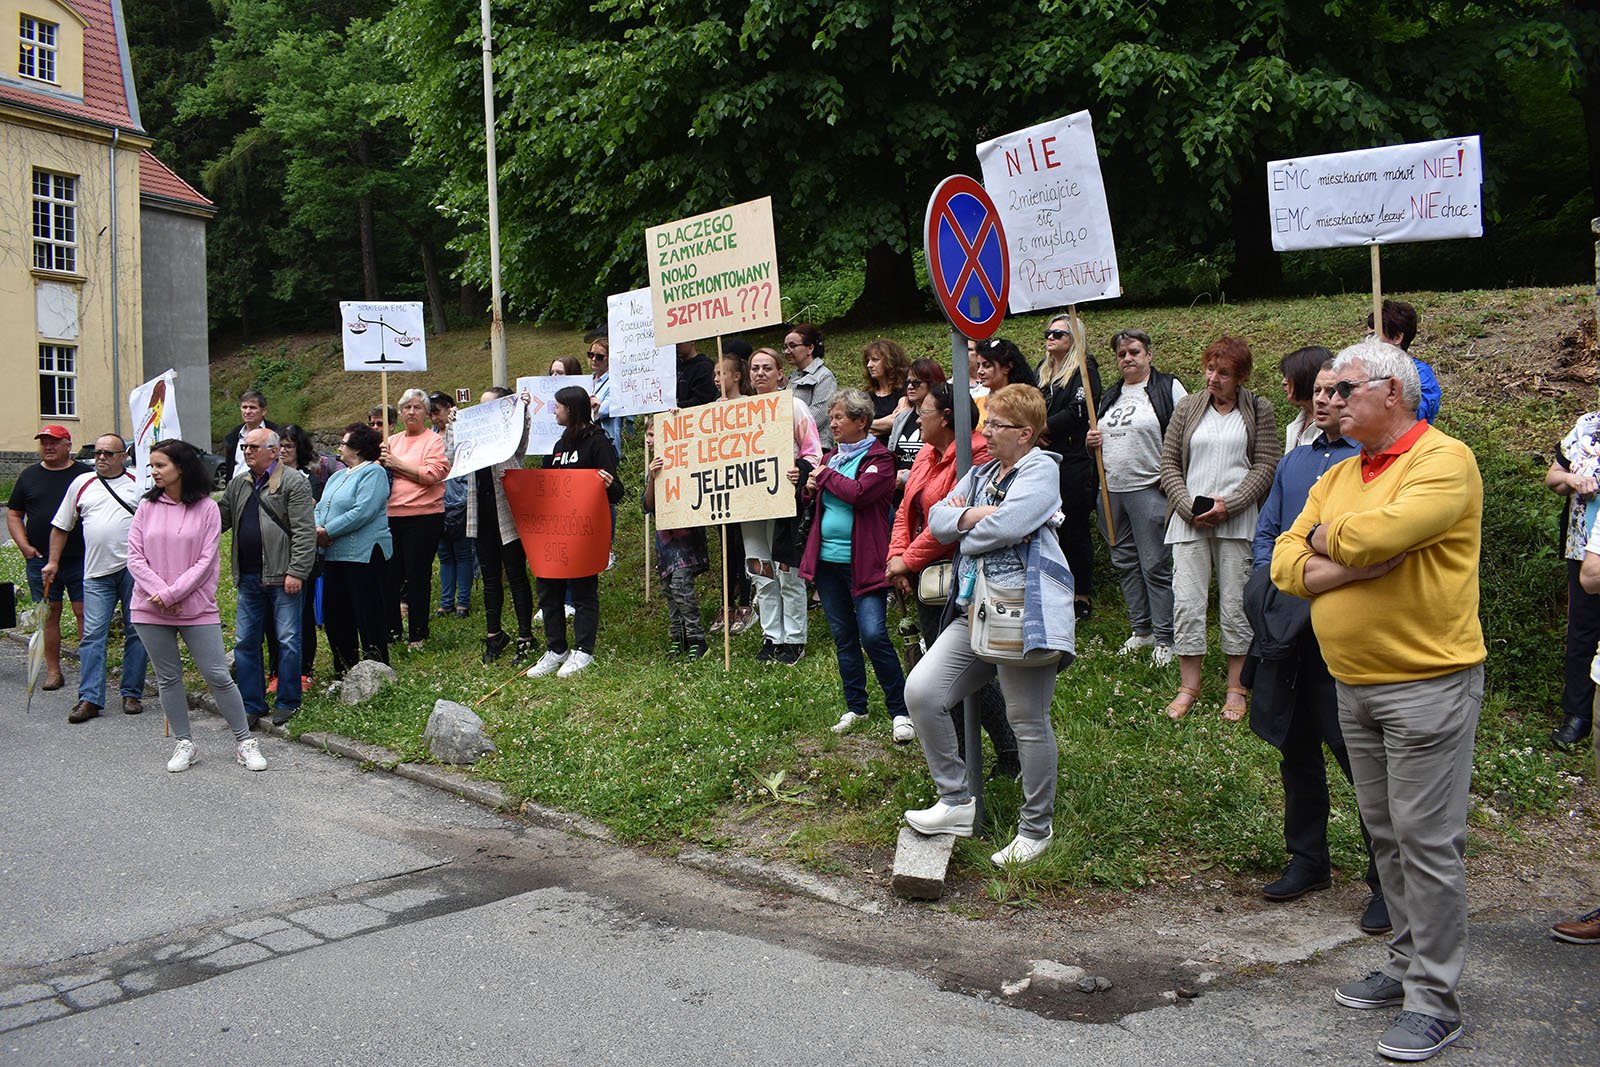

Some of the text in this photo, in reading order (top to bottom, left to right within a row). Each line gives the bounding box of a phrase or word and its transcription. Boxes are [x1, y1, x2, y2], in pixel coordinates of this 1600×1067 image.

[1005, 136, 1061, 177] NIE
[1274, 149, 1464, 191] EMC mieszkańcom mówi NIE!
[1008, 179, 1081, 212] Zmieniajcie
[656, 213, 733, 249] DLACZEGO
[1036, 209, 1055, 227] się
[1275, 206, 1311, 233] EMC
[1316, 210, 1375, 228] mieszkańców
[1376, 203, 1406, 227] leczyć
[659, 232, 737, 267] ZAMYKACIE
[1031, 221, 1077, 260] myślą
[1078, 227, 1088, 240] o
[661, 263, 697, 286] NOWO
[663, 261, 771, 304] WYREMONTOWANY
[391, 304, 407, 312] EMC
[630, 299, 644, 316] Nie
[666, 282, 773, 328] SZPITAL ???
[624, 334, 634, 348] po
[616, 350, 626, 365] To
[641, 378, 650, 391] IT
[663, 396, 780, 444] NIE CHCEMY
[552, 450, 579, 466] FILA
[663, 423, 766, 470] SIĘ LECZYĆ
[535, 475, 571, 498] EMC
[665, 456, 779, 511] W JELENIEJ
[709, 492, 731, 521] !!!
[544, 542, 569, 566] SIĘ
